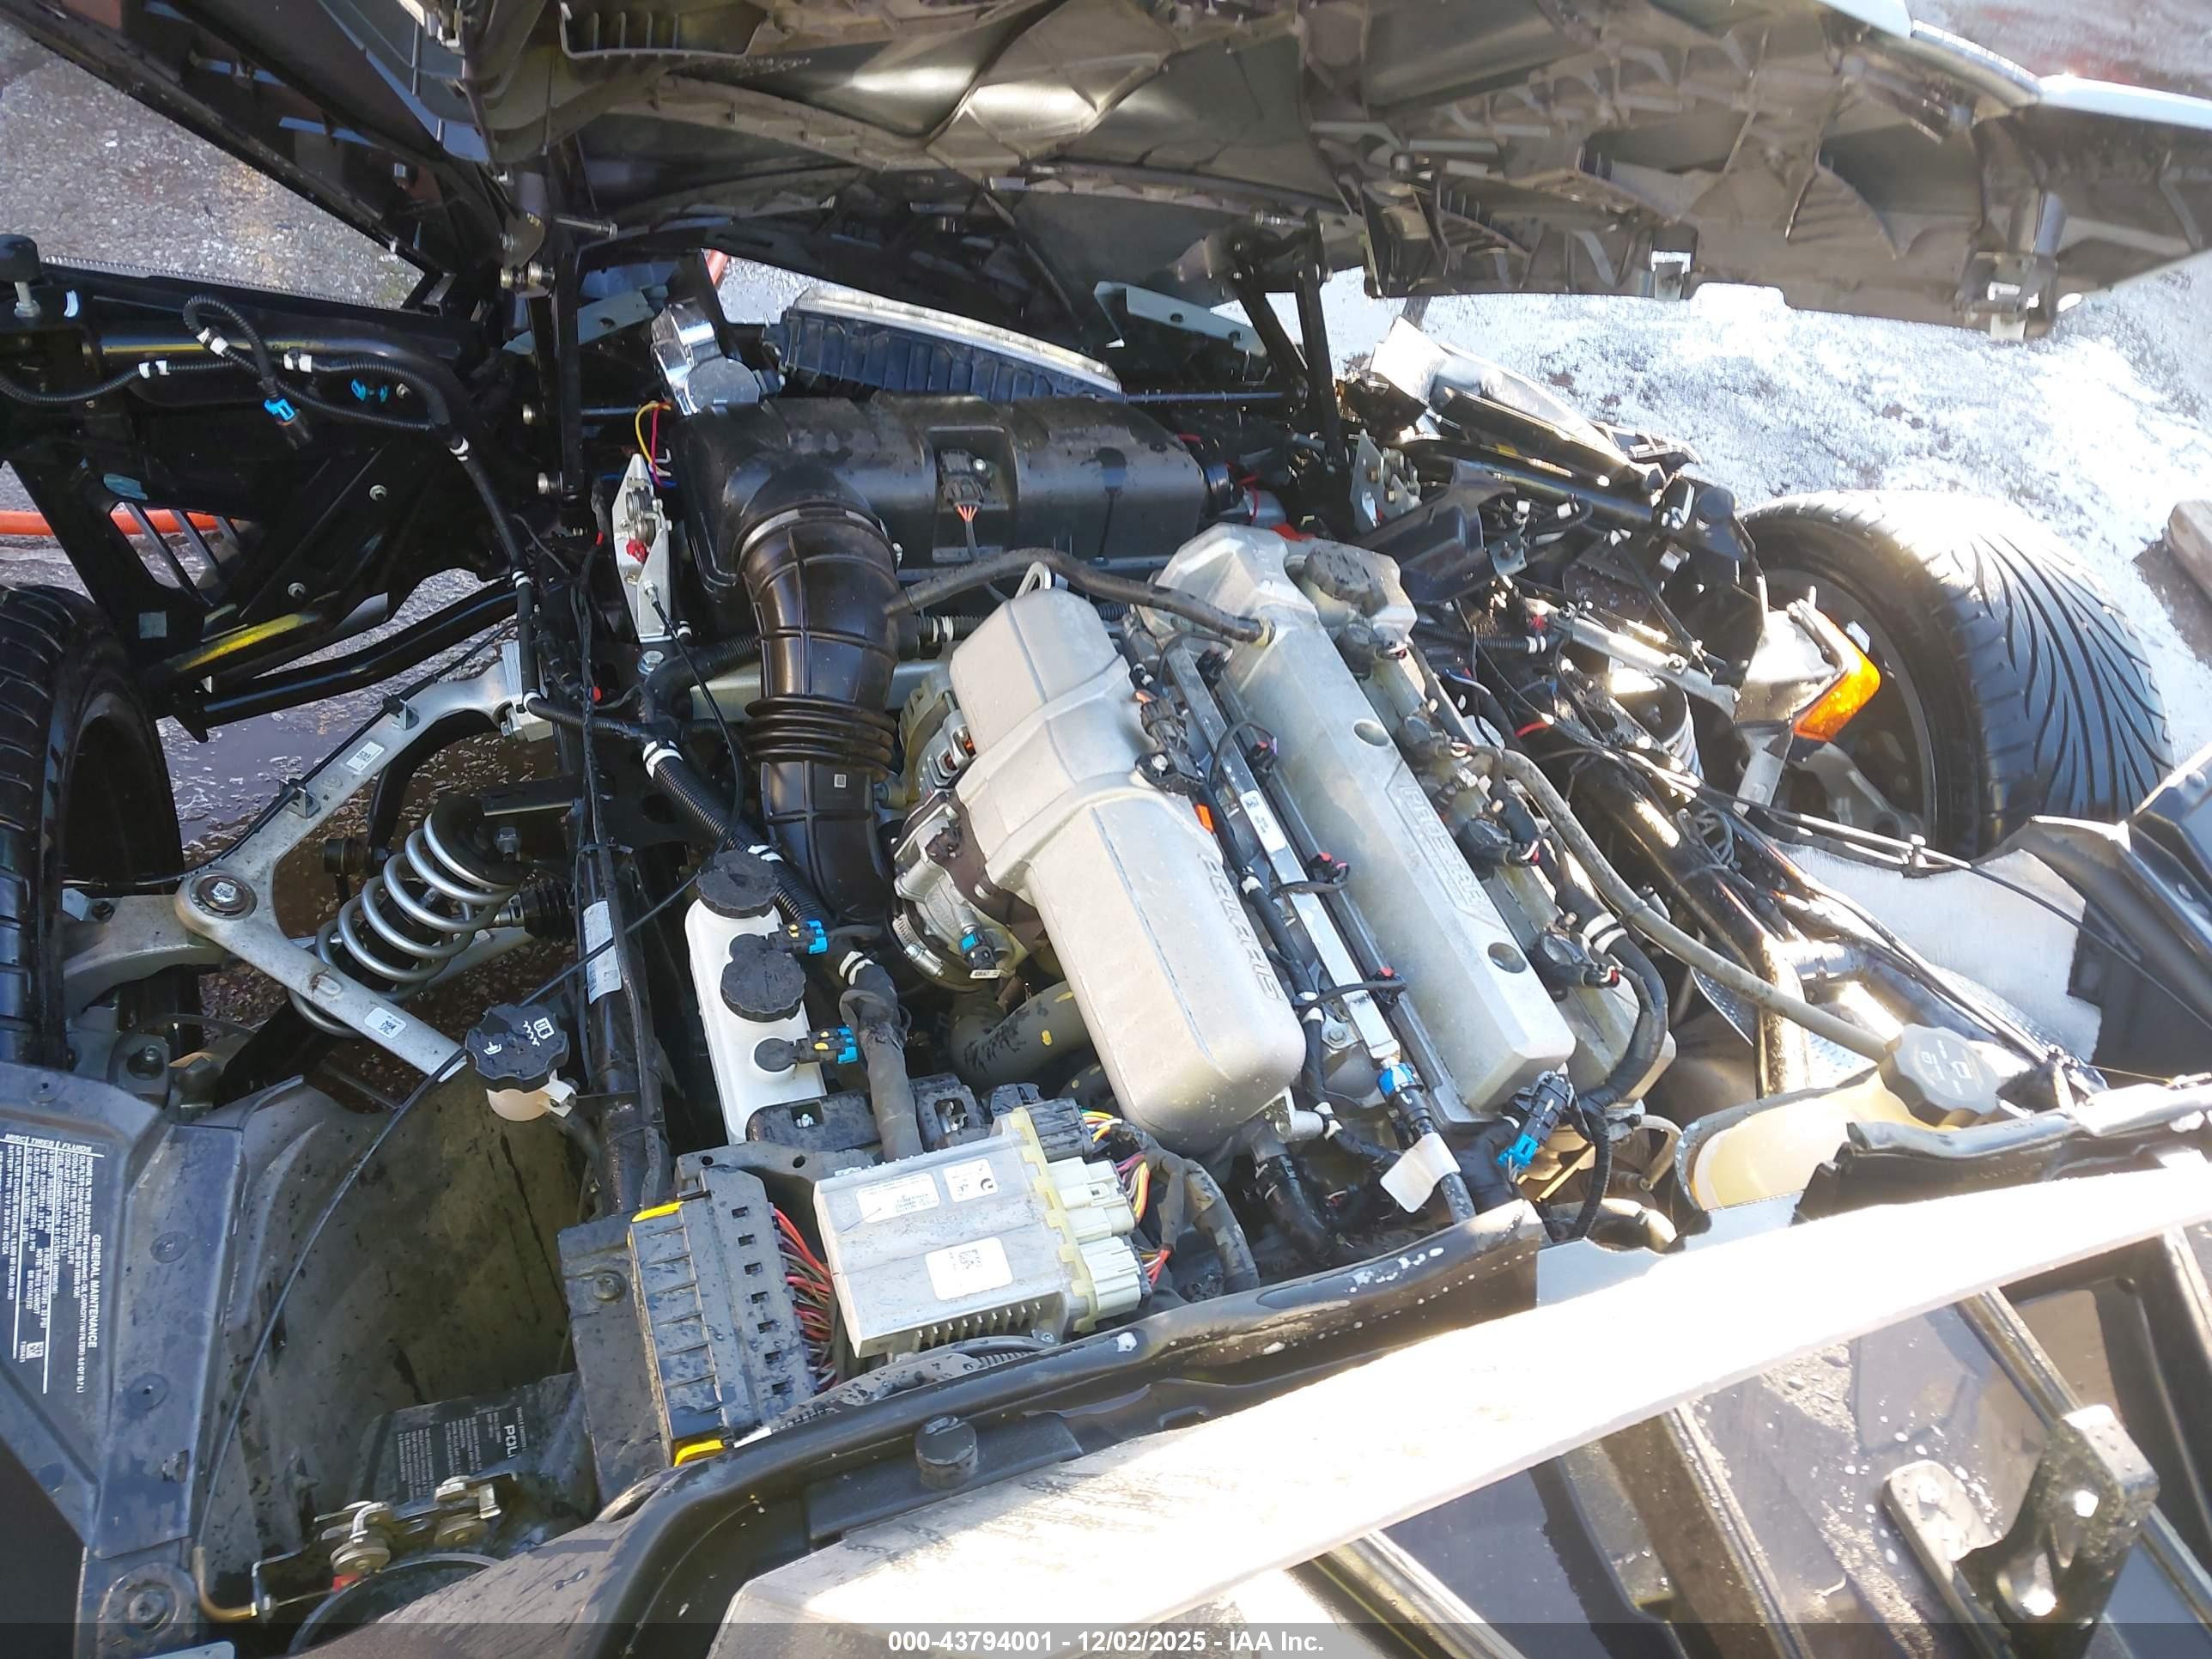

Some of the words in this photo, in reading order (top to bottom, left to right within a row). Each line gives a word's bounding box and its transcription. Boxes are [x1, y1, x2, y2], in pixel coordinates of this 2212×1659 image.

[1401, 786, 1486, 904] PROSTAR
[1199, 854, 1281, 1001] POLARIS
[4, 1134, 27, 1143] MISC
[31, 1138, 54, 1147] TIRES
[61, 1143, 92, 1152] FLUIDS
[62, 1182, 70, 1212] CAPACITY:
[10, 1204, 19, 1237] INTERVAL:
[61, 1228, 68, 1237] QT
[27, 1242, 36, 1252] PSI
[90, 1234, 101, 1278] GENERAL
[7, 1266, 16, 1286] (24,000
[27, 1270, 34, 1279] BE
[25, 1279, 33, 1310] ROTATED
[88, 1279, 100, 1348] MAINTENANCE
[503, 1425, 517, 1458] POL
